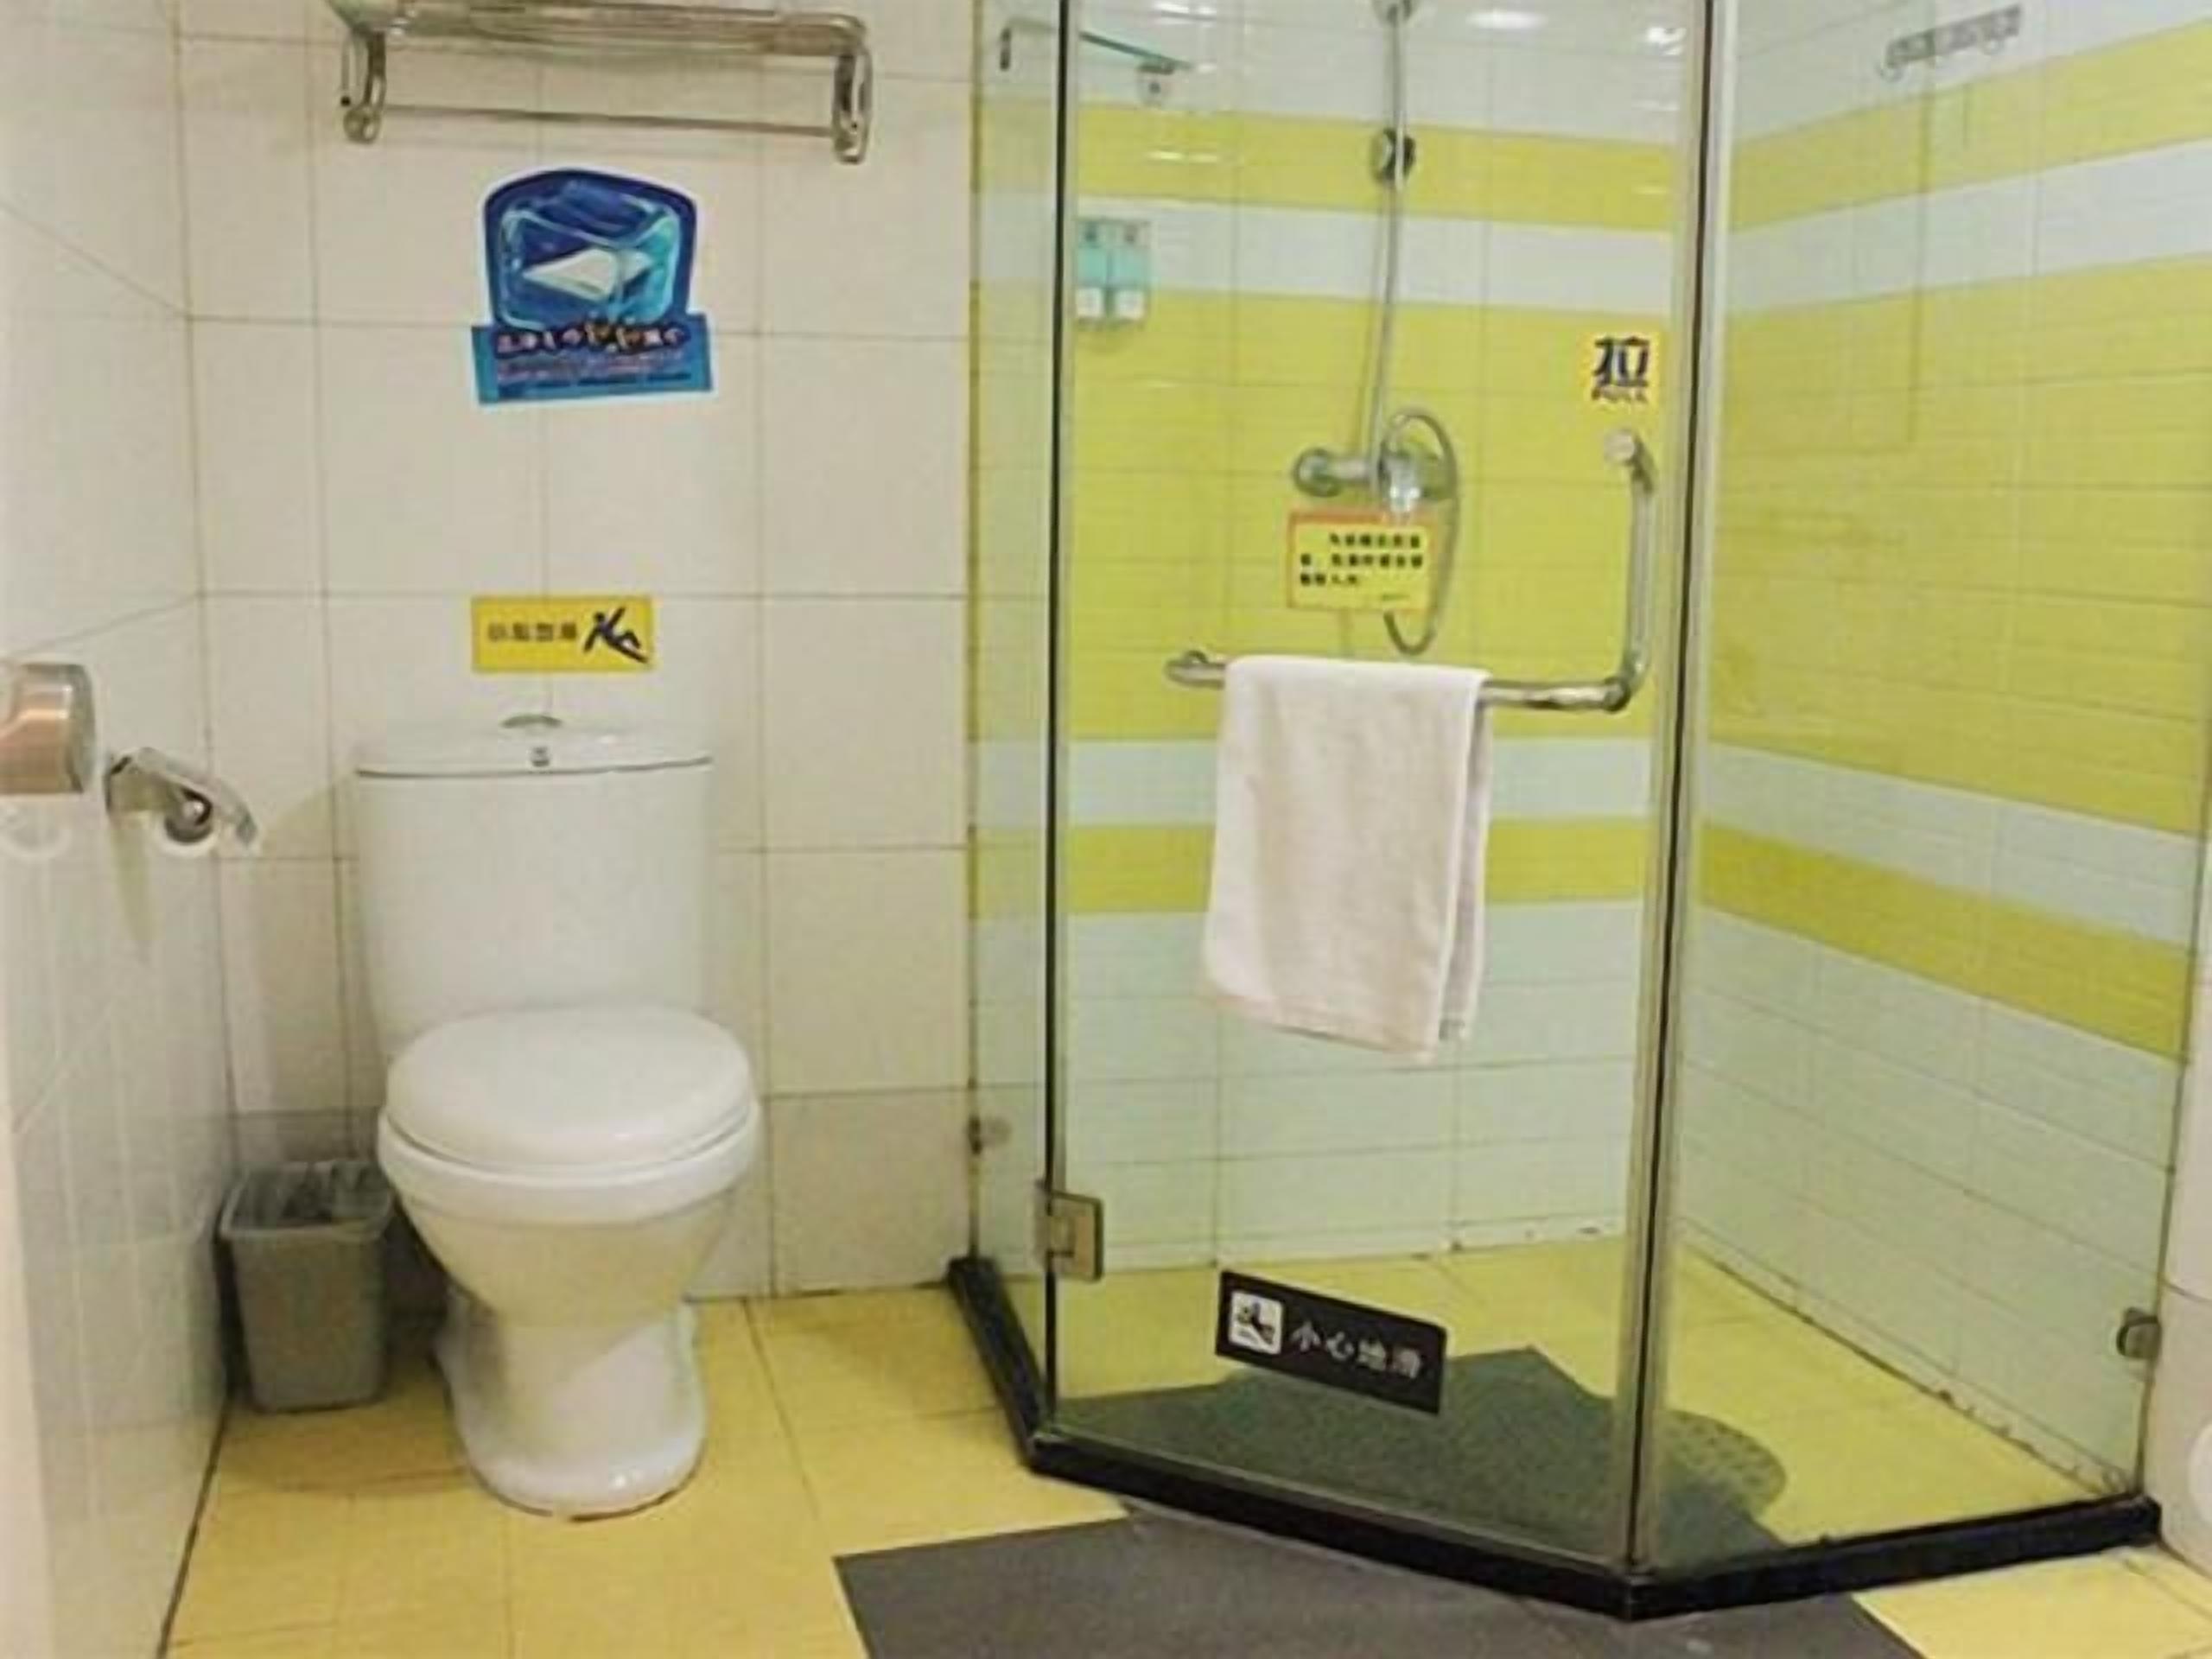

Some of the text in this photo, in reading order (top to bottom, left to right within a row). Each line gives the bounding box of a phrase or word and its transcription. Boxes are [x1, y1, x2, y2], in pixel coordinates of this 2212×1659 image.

[1592, 336, 1650, 387] 拉
[1293, 1320, 1423, 1380] 小心地滑
